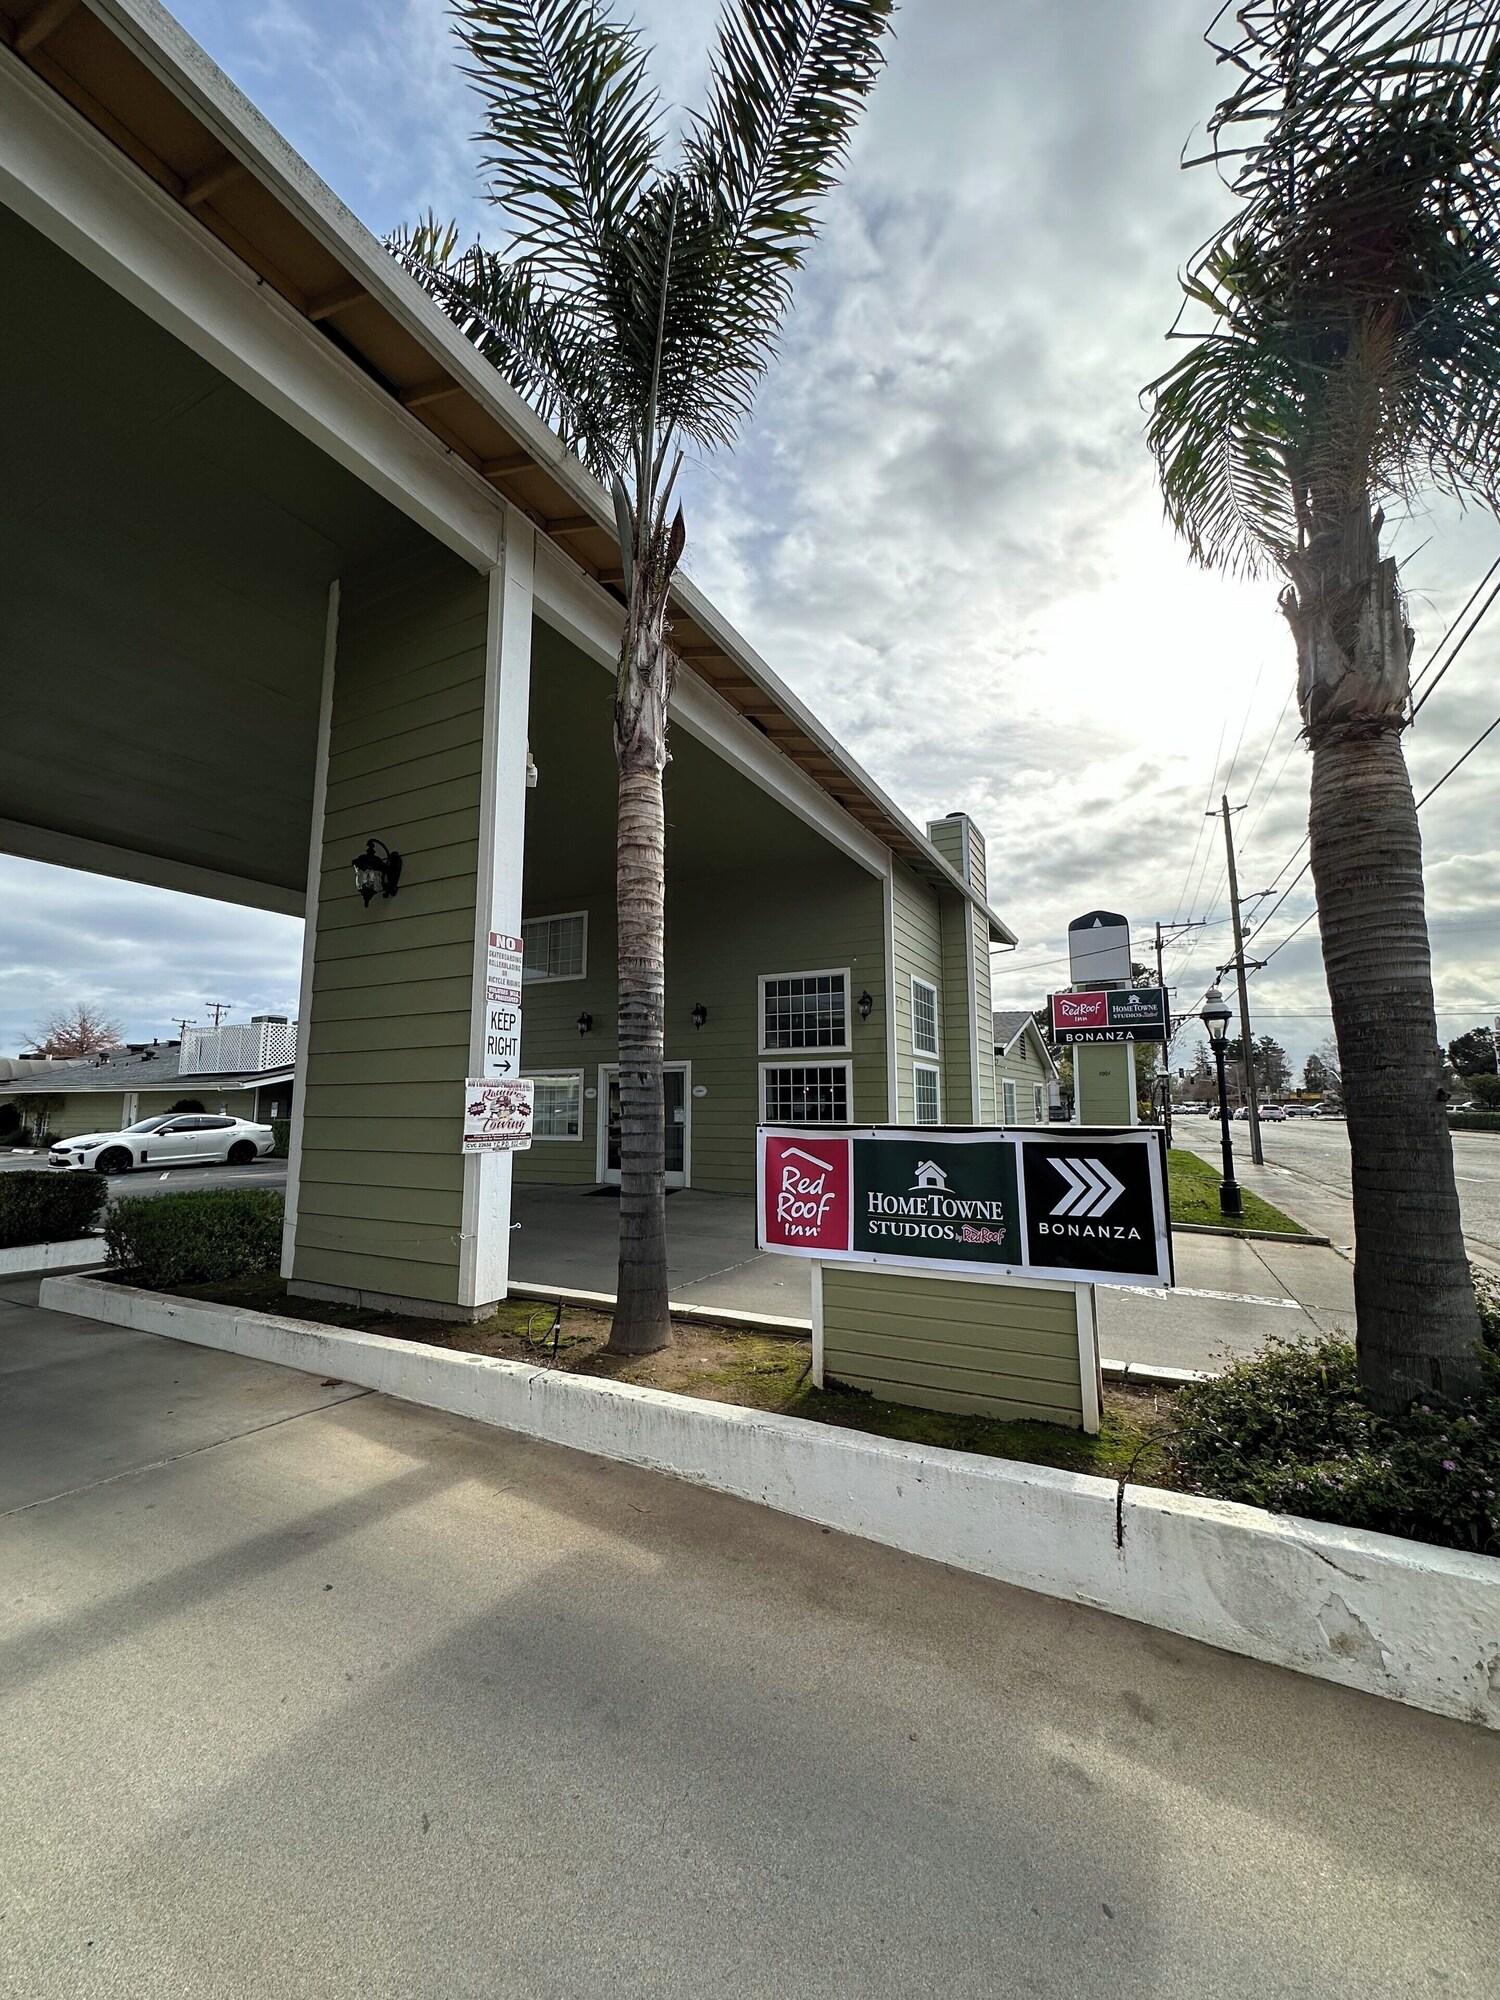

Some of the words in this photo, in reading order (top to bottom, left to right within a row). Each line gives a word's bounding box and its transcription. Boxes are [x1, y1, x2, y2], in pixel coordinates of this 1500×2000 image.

[496, 934, 516, 951] NO
[490, 1011, 517, 1031] KEEP
[487, 1036, 518, 1056] RIGHT
[1065, 1031, 1135, 1042] BONANZA
[477, 1117, 525, 1134] Towing
[782, 1166, 826, 1194] Red
[777, 1192, 835, 1225] Roof
[868, 1220, 954, 1239] STUDIOS
[1039, 1222, 1141, 1240] BONANZA
